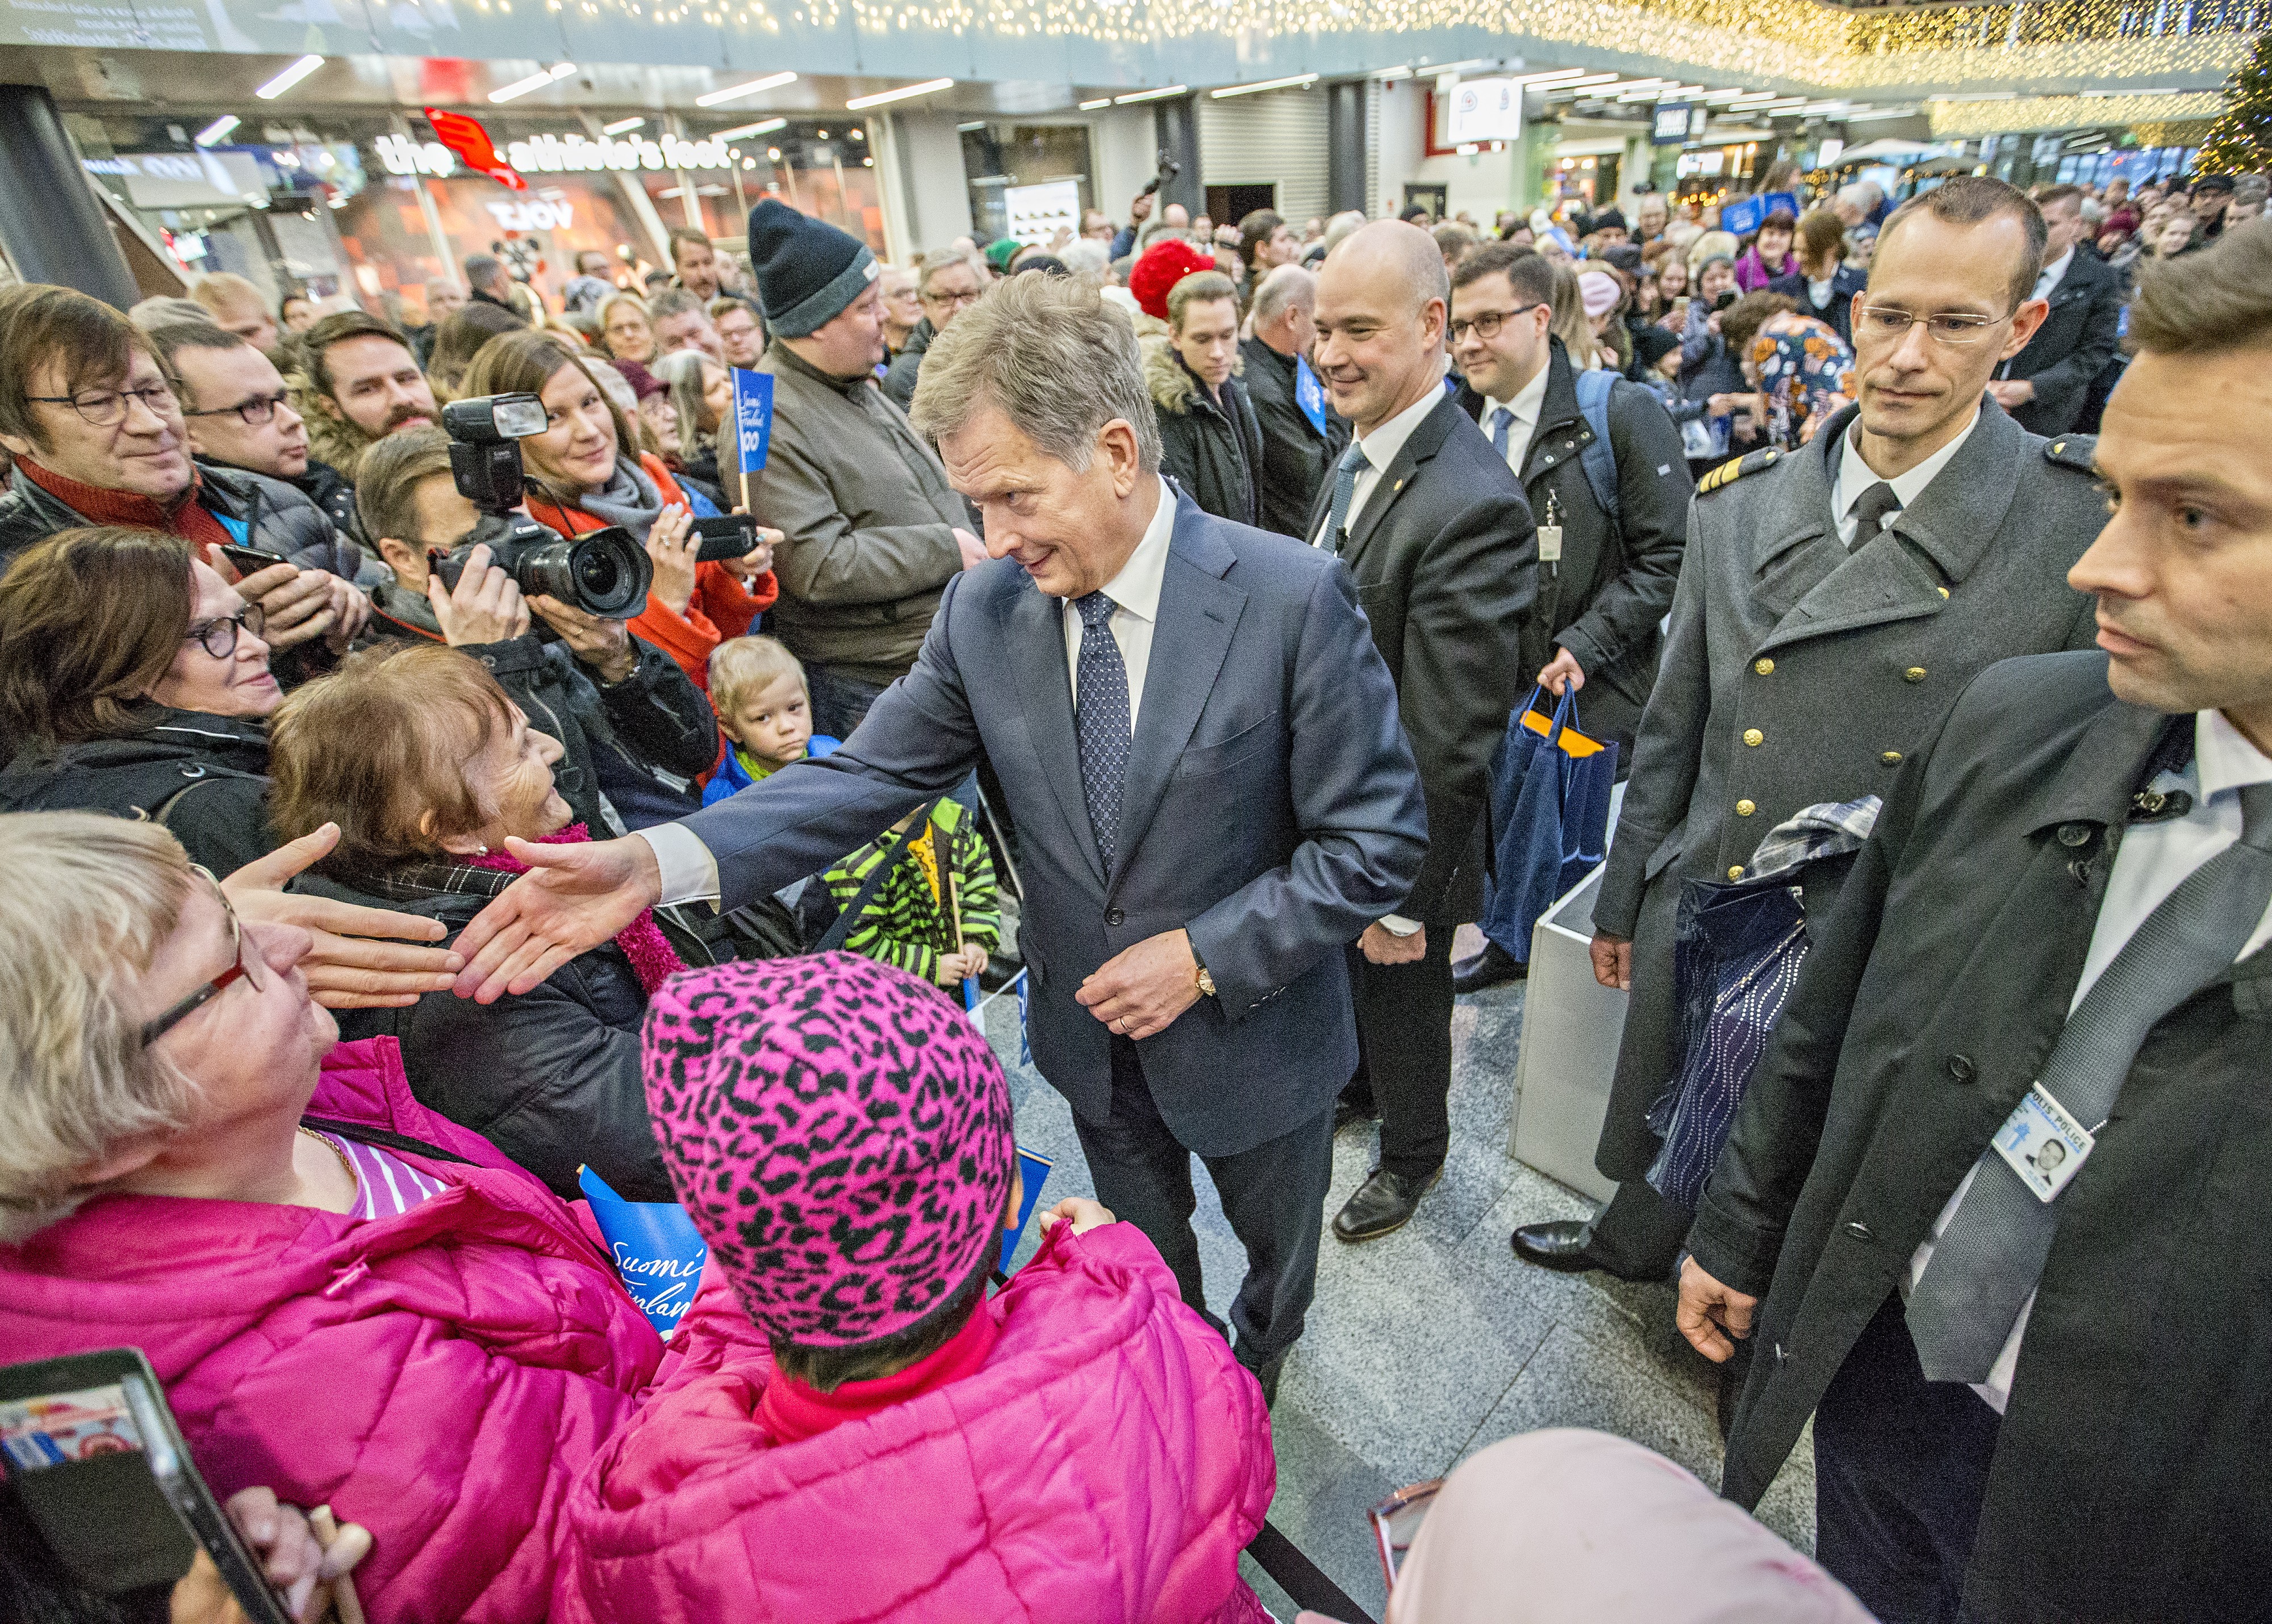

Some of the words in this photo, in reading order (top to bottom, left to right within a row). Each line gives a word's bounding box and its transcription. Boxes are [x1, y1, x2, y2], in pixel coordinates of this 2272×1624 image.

[374, 133, 455, 178] the
[743, 430, 760, 453] 00
[2054, 1115, 2086, 1151] POLICE
[613, 1241, 704, 1278] Suomi
[620, 1272, 691, 1318] inlan
